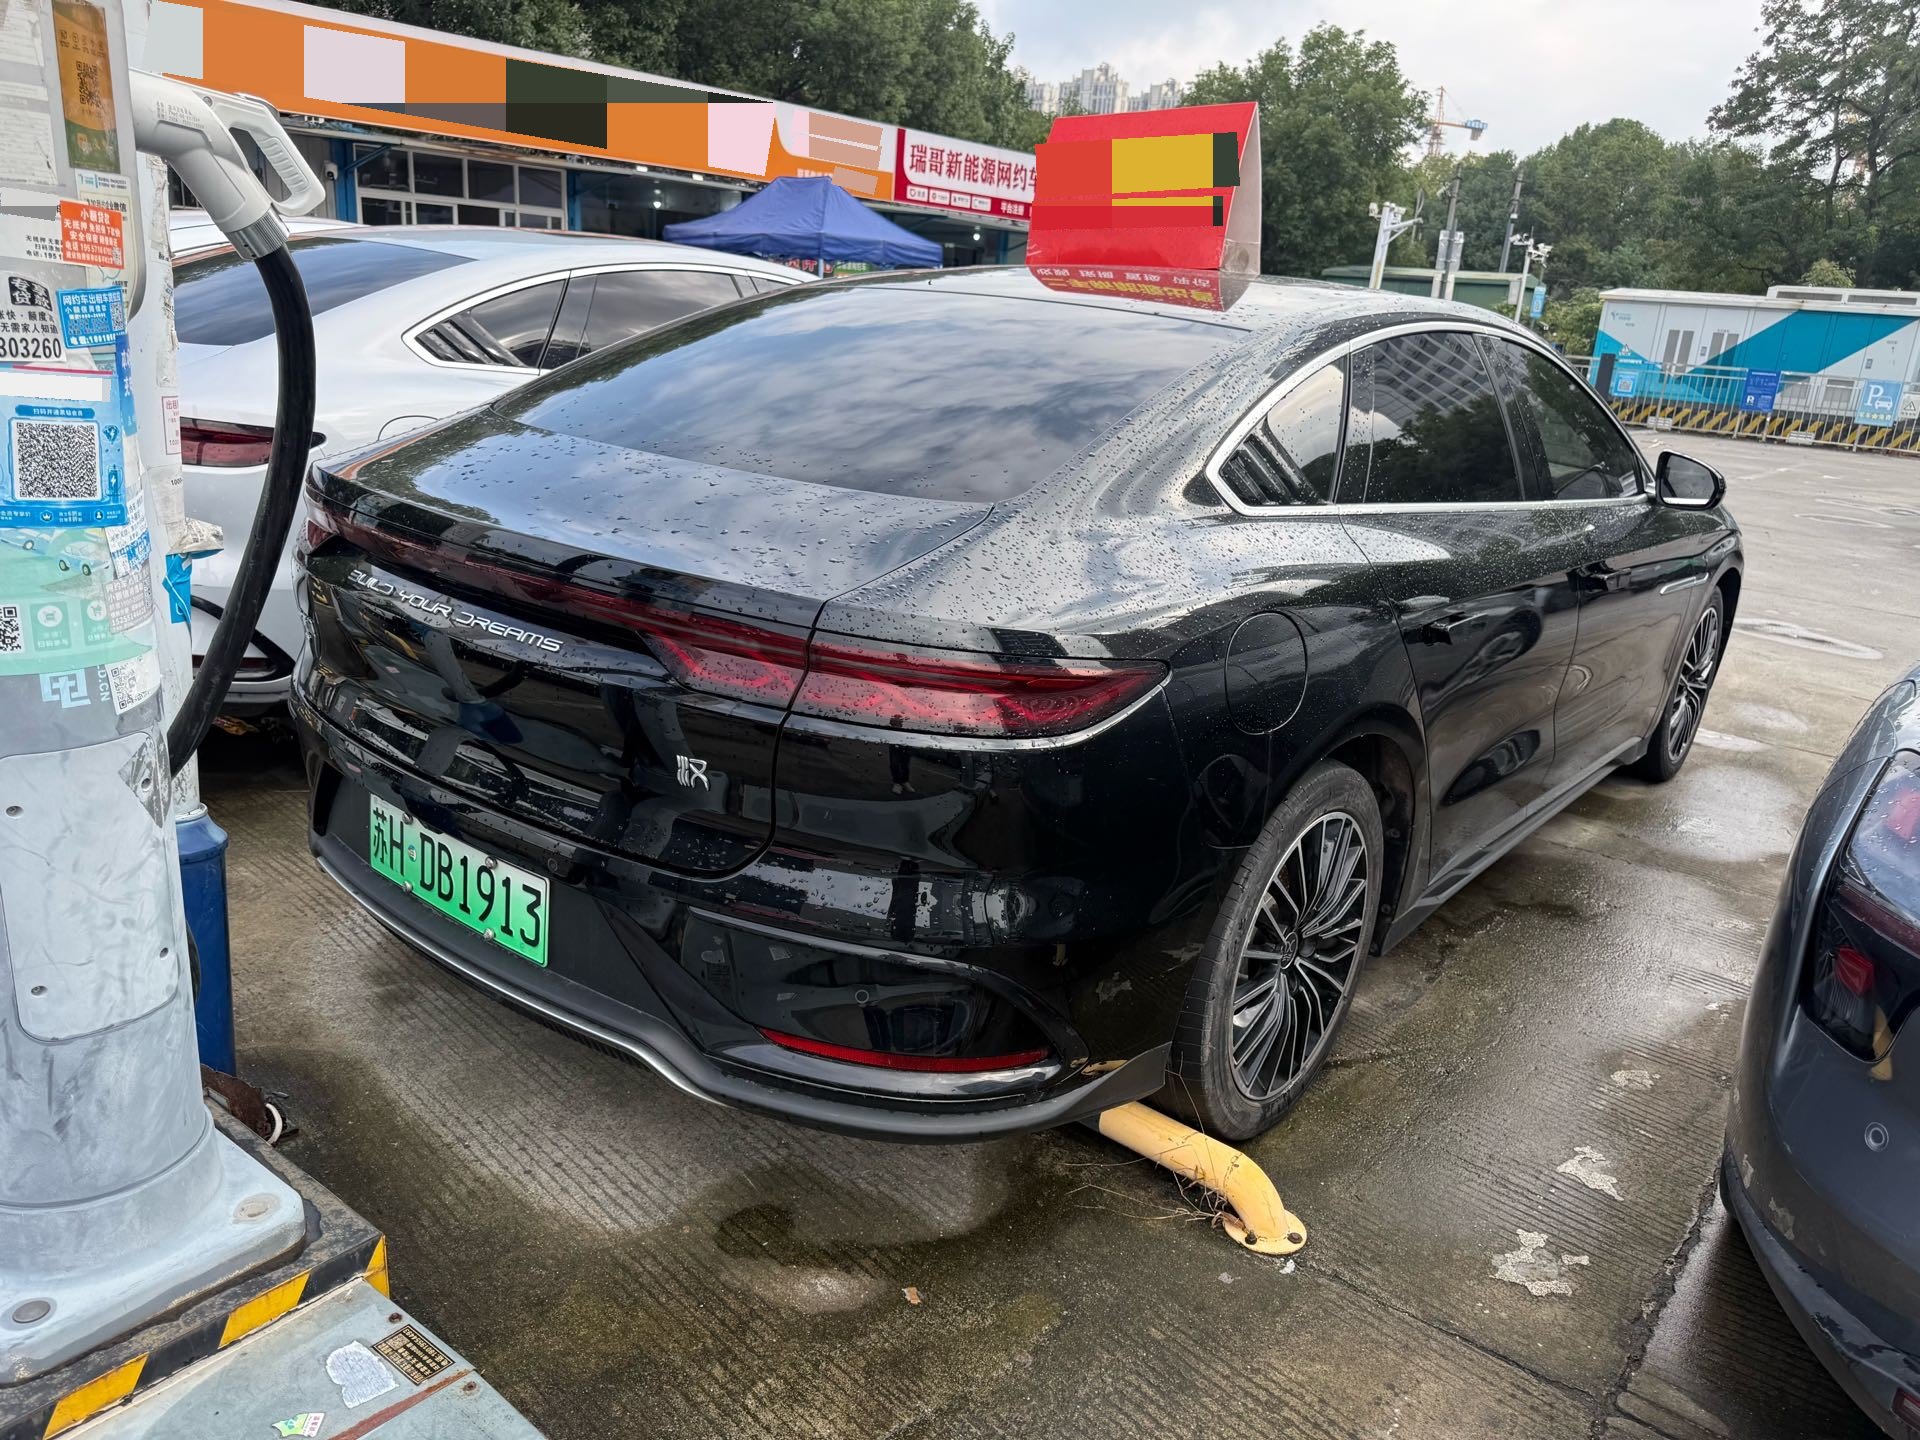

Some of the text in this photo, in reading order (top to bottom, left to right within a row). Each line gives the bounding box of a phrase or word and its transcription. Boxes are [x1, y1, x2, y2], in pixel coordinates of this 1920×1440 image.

[1864, 384, 1884, 406] P
[348, 569, 564, 652] BUILD YOUR DREAMS
